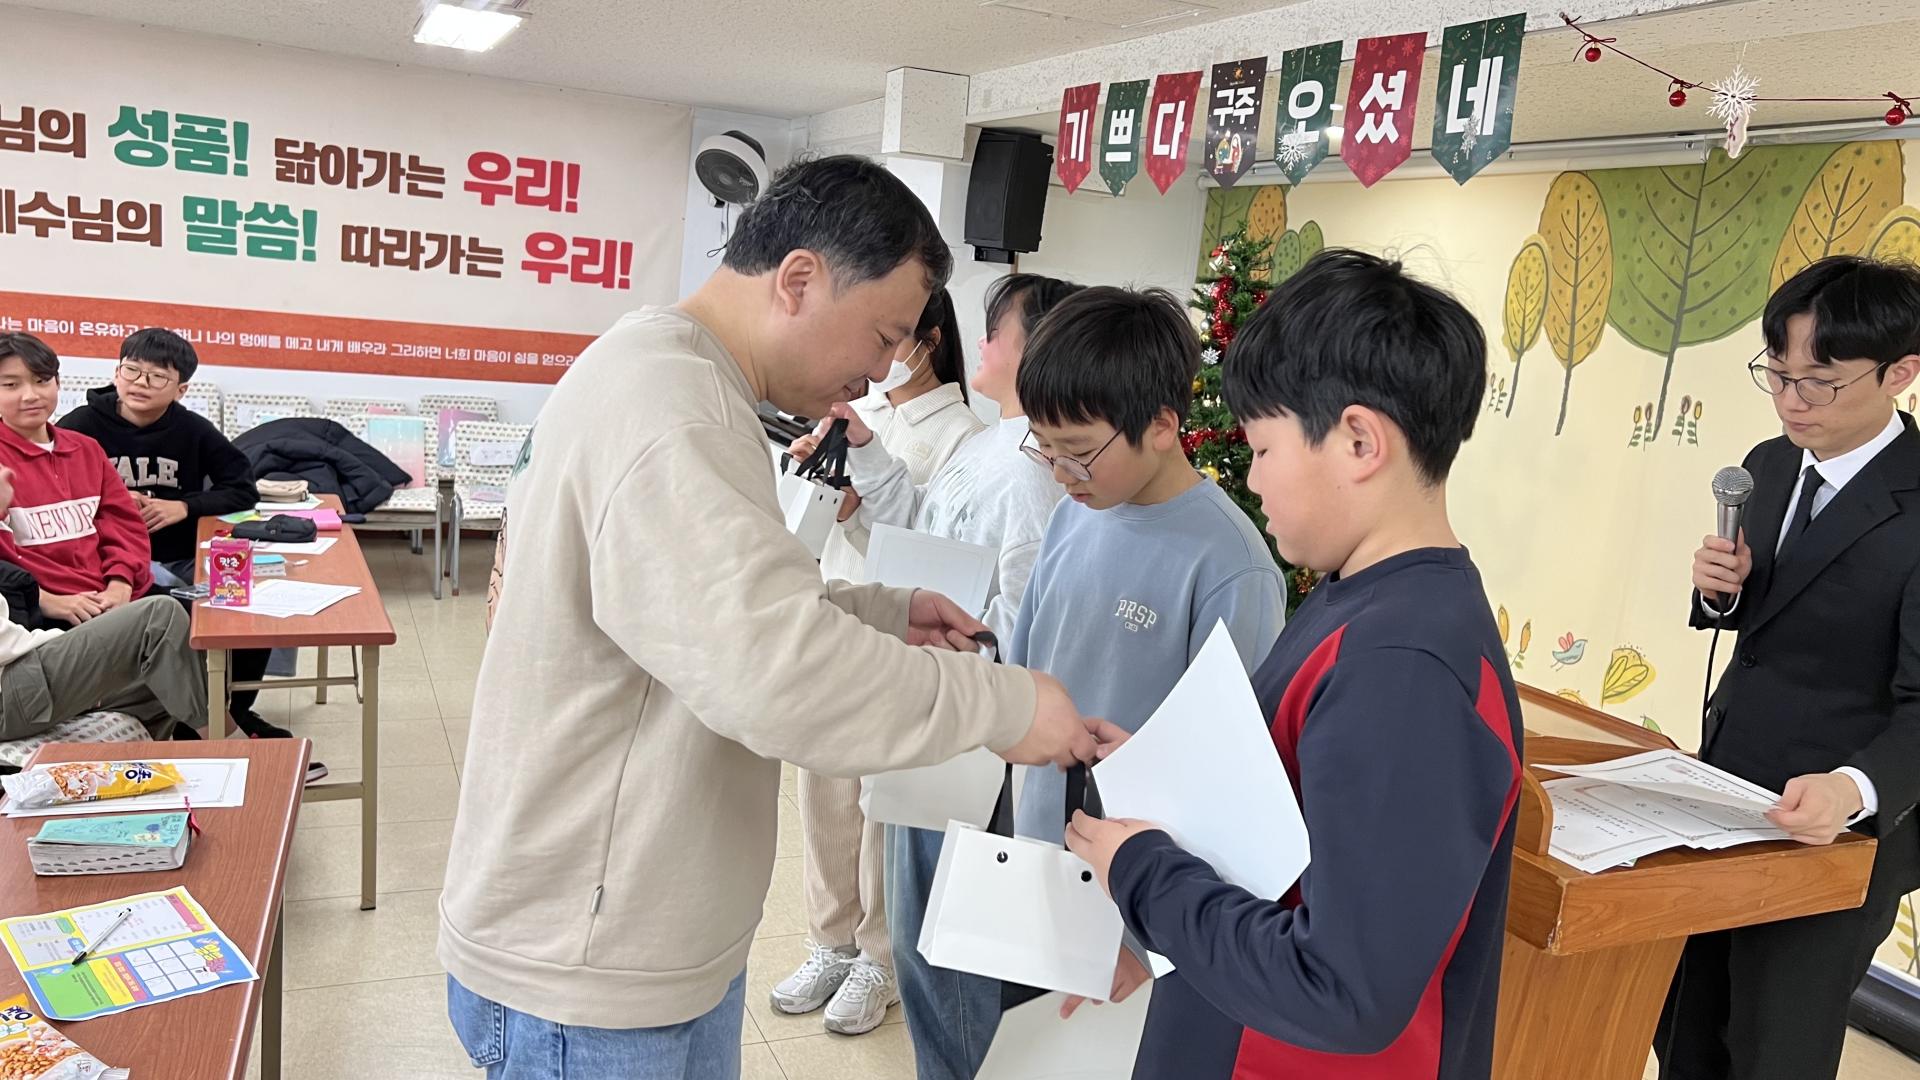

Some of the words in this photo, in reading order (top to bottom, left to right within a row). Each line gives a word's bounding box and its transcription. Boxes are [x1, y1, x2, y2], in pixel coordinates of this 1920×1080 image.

[1213, 86, 1256, 127] 구주
[108, 105, 249, 176] 성품!
[274, 138, 446, 199] 닮아가는
[464, 151, 580, 213] 우리!
[183, 195, 318, 262] 말씀!
[341, 224, 504, 279] 따라가는
[521, 231, 633, 290] 우리!
[27, 318, 74, 334] 마음이
[79, 321, 138, 338] 온유하고
[206, 330, 235, 345] 나의
[240, 333, 281, 349] 멍에를
[285, 336, 313, 351] 메고
[316, 338, 343, 353] 내게
[347, 340, 387, 355] 배우라
[391, 343, 441, 359] 그리하면
[445, 347, 470, 361] 너희
[474, 349, 510, 363] 마음이
[1114, 599, 1157, 629] PRSP
